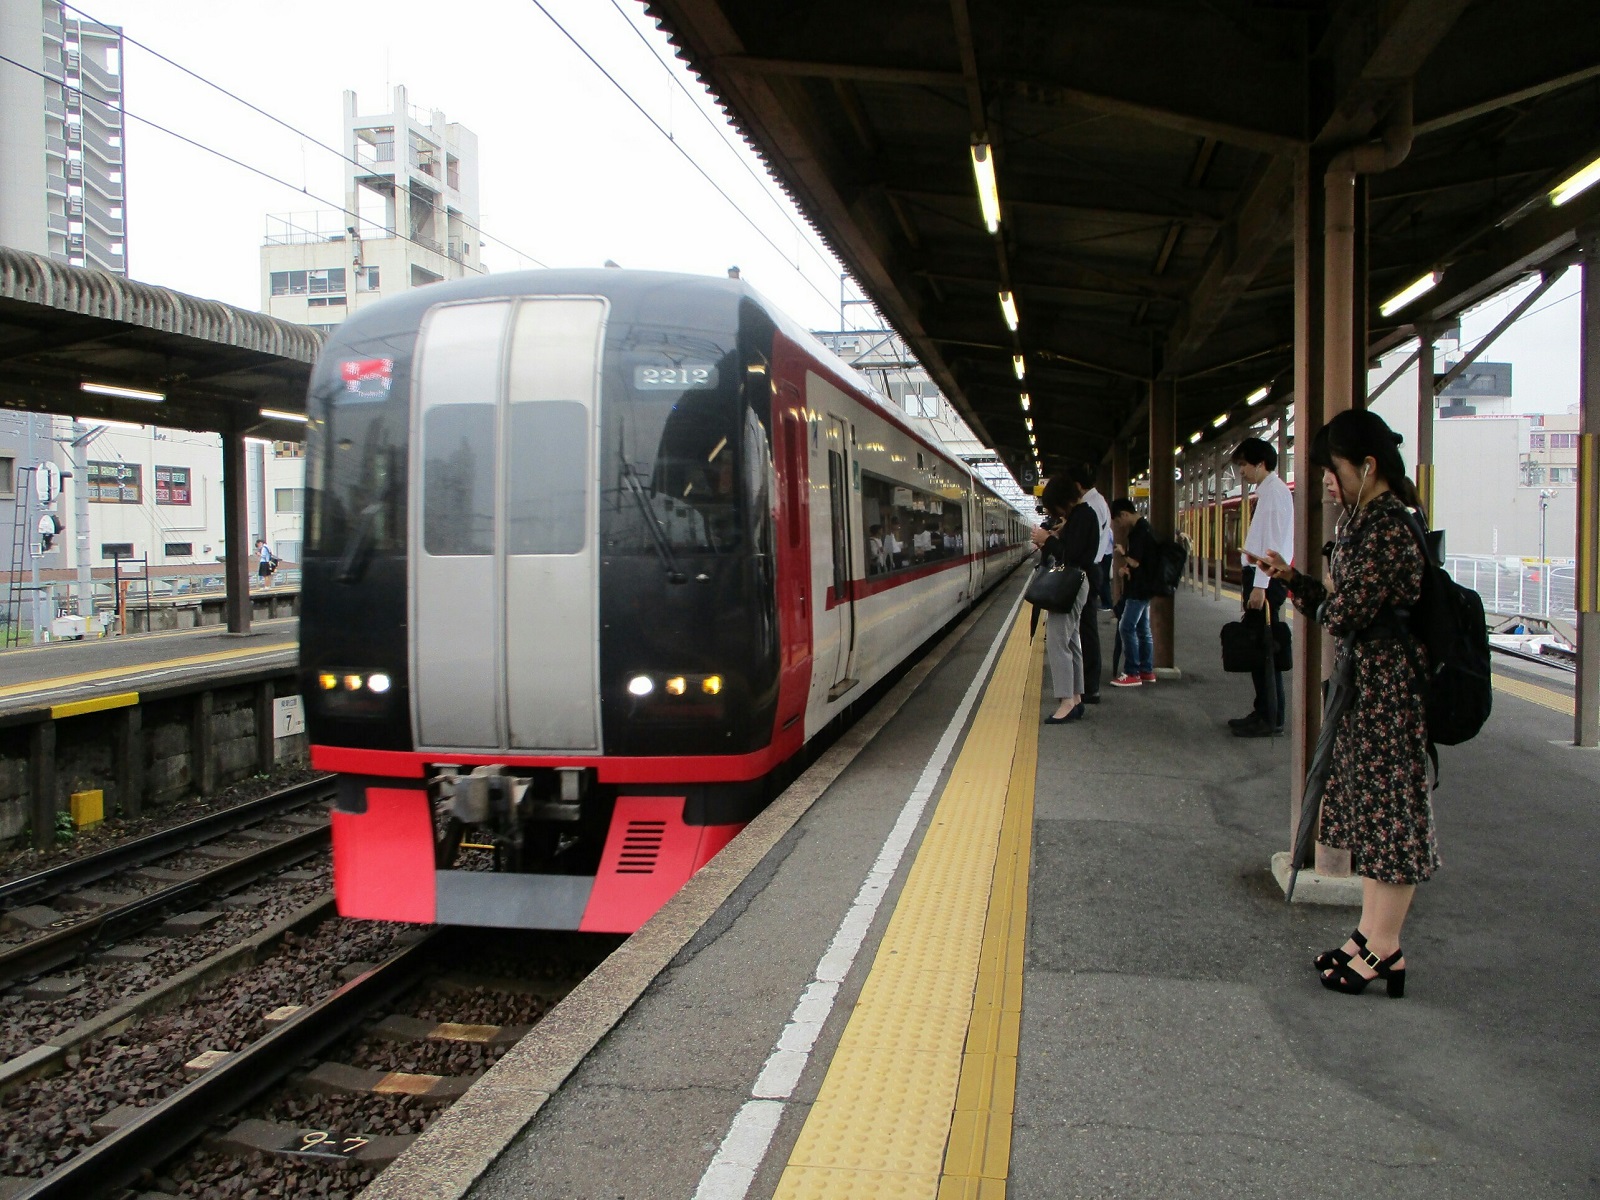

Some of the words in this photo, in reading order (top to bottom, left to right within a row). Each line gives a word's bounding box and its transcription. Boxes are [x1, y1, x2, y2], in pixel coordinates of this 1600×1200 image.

[642, 368, 709, 384] 2212
[1024, 469, 1034, 482] 5
[286, 714, 292, 731] 7
